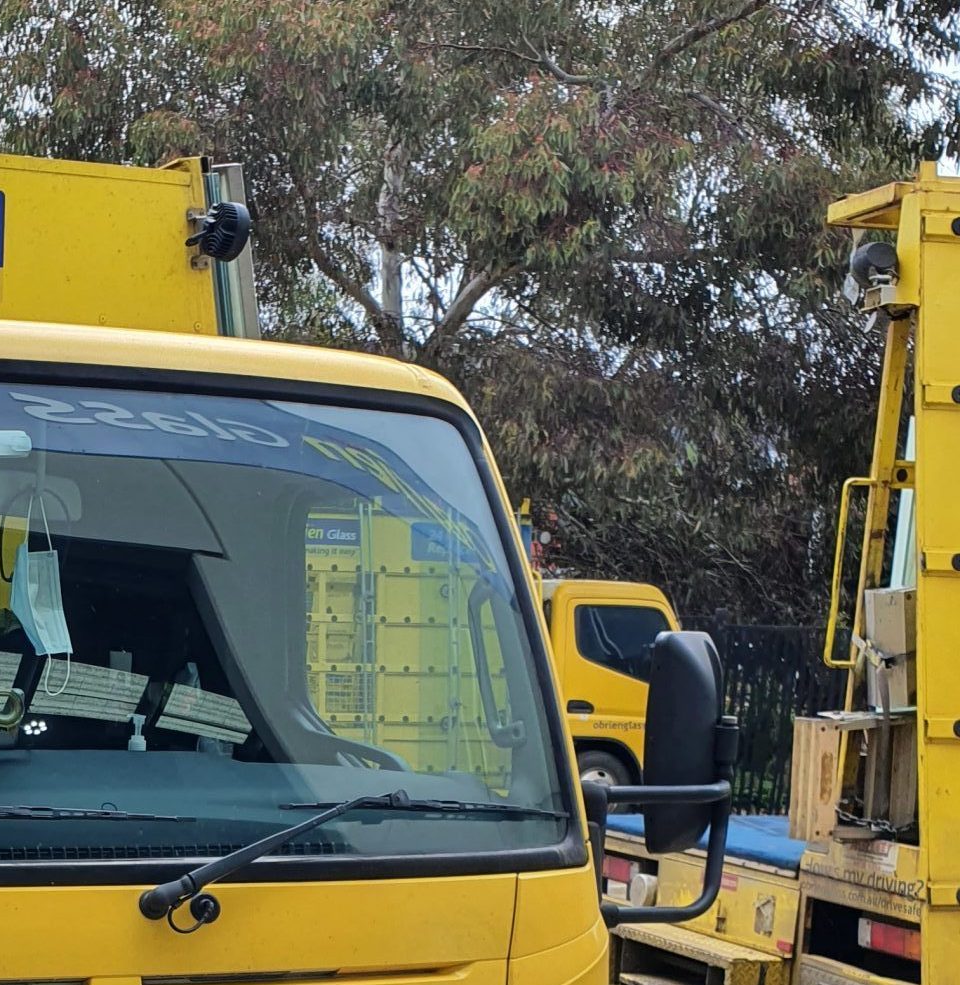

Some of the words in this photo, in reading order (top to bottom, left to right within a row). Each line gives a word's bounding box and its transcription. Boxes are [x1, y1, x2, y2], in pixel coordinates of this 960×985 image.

[327, 528, 357, 541] Glass
[843, 867, 865, 885] my
[867, 870, 925, 902] driving?
